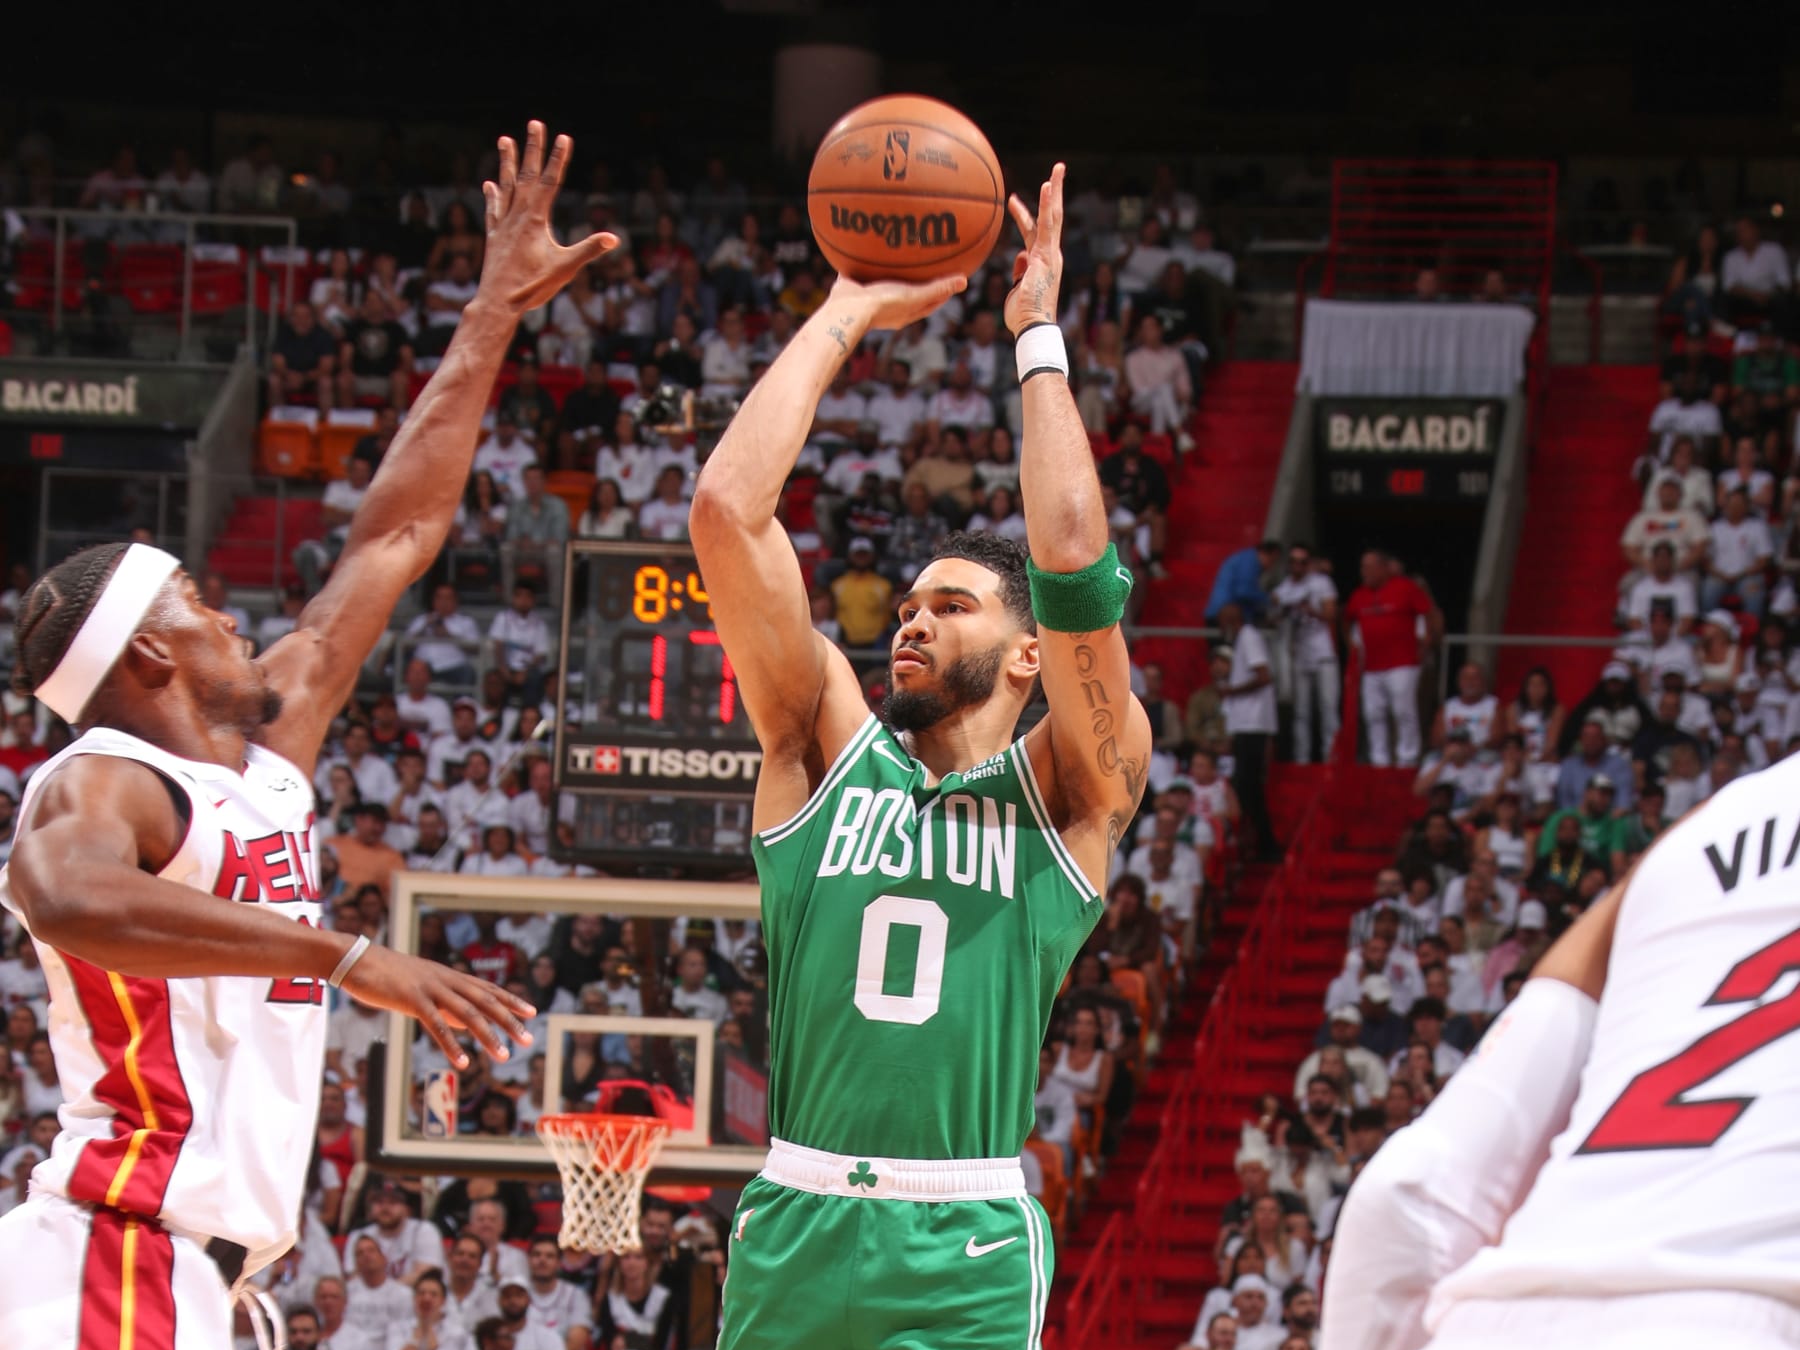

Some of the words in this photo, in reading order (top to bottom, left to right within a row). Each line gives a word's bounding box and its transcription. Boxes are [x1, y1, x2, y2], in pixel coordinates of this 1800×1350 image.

[830, 203, 960, 248] Wilson
[3, 375, 139, 415] BACARDÍ
[1329, 406, 1490, 450] BACARDÍ
[623, 748, 763, 780] TISSOT
[962, 763, 1006, 784] PRINT
[816, 786, 1017, 899] BOSTON
[854, 895, 949, 1026] 0
